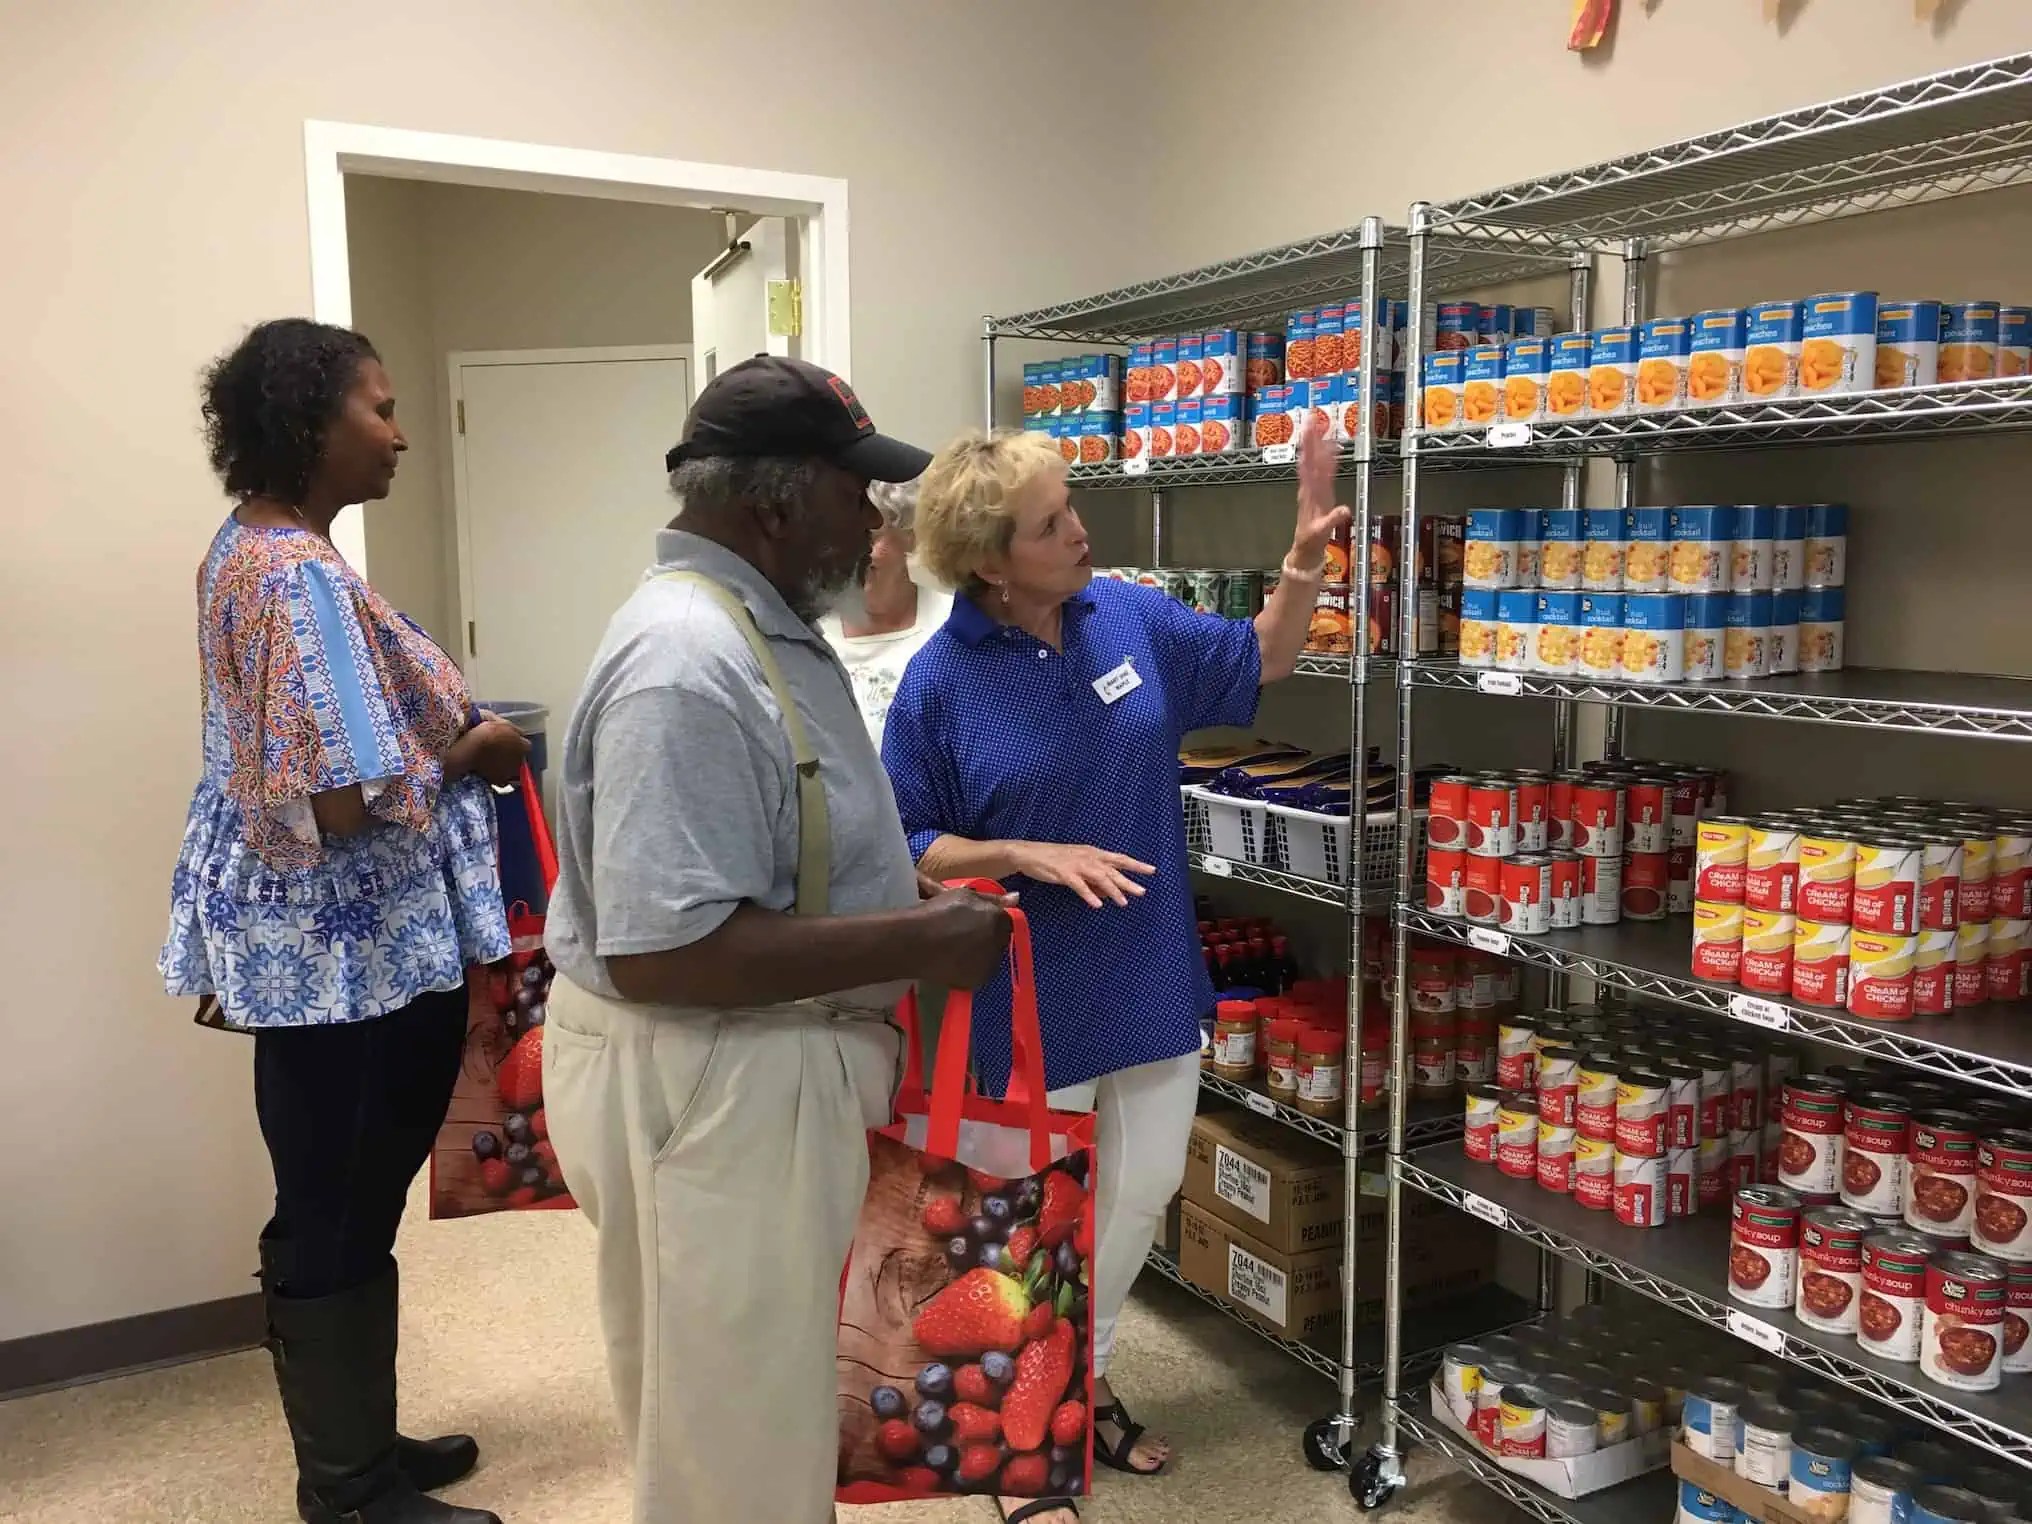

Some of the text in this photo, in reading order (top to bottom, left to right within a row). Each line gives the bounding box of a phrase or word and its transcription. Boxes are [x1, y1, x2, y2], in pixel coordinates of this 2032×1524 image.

[1219, 1150, 1241, 1172] 7044
[1231, 1250, 1255, 1273] 7044
[1886, 1278, 1913, 1293] soup
[1944, 1300, 1985, 1318] chunky
